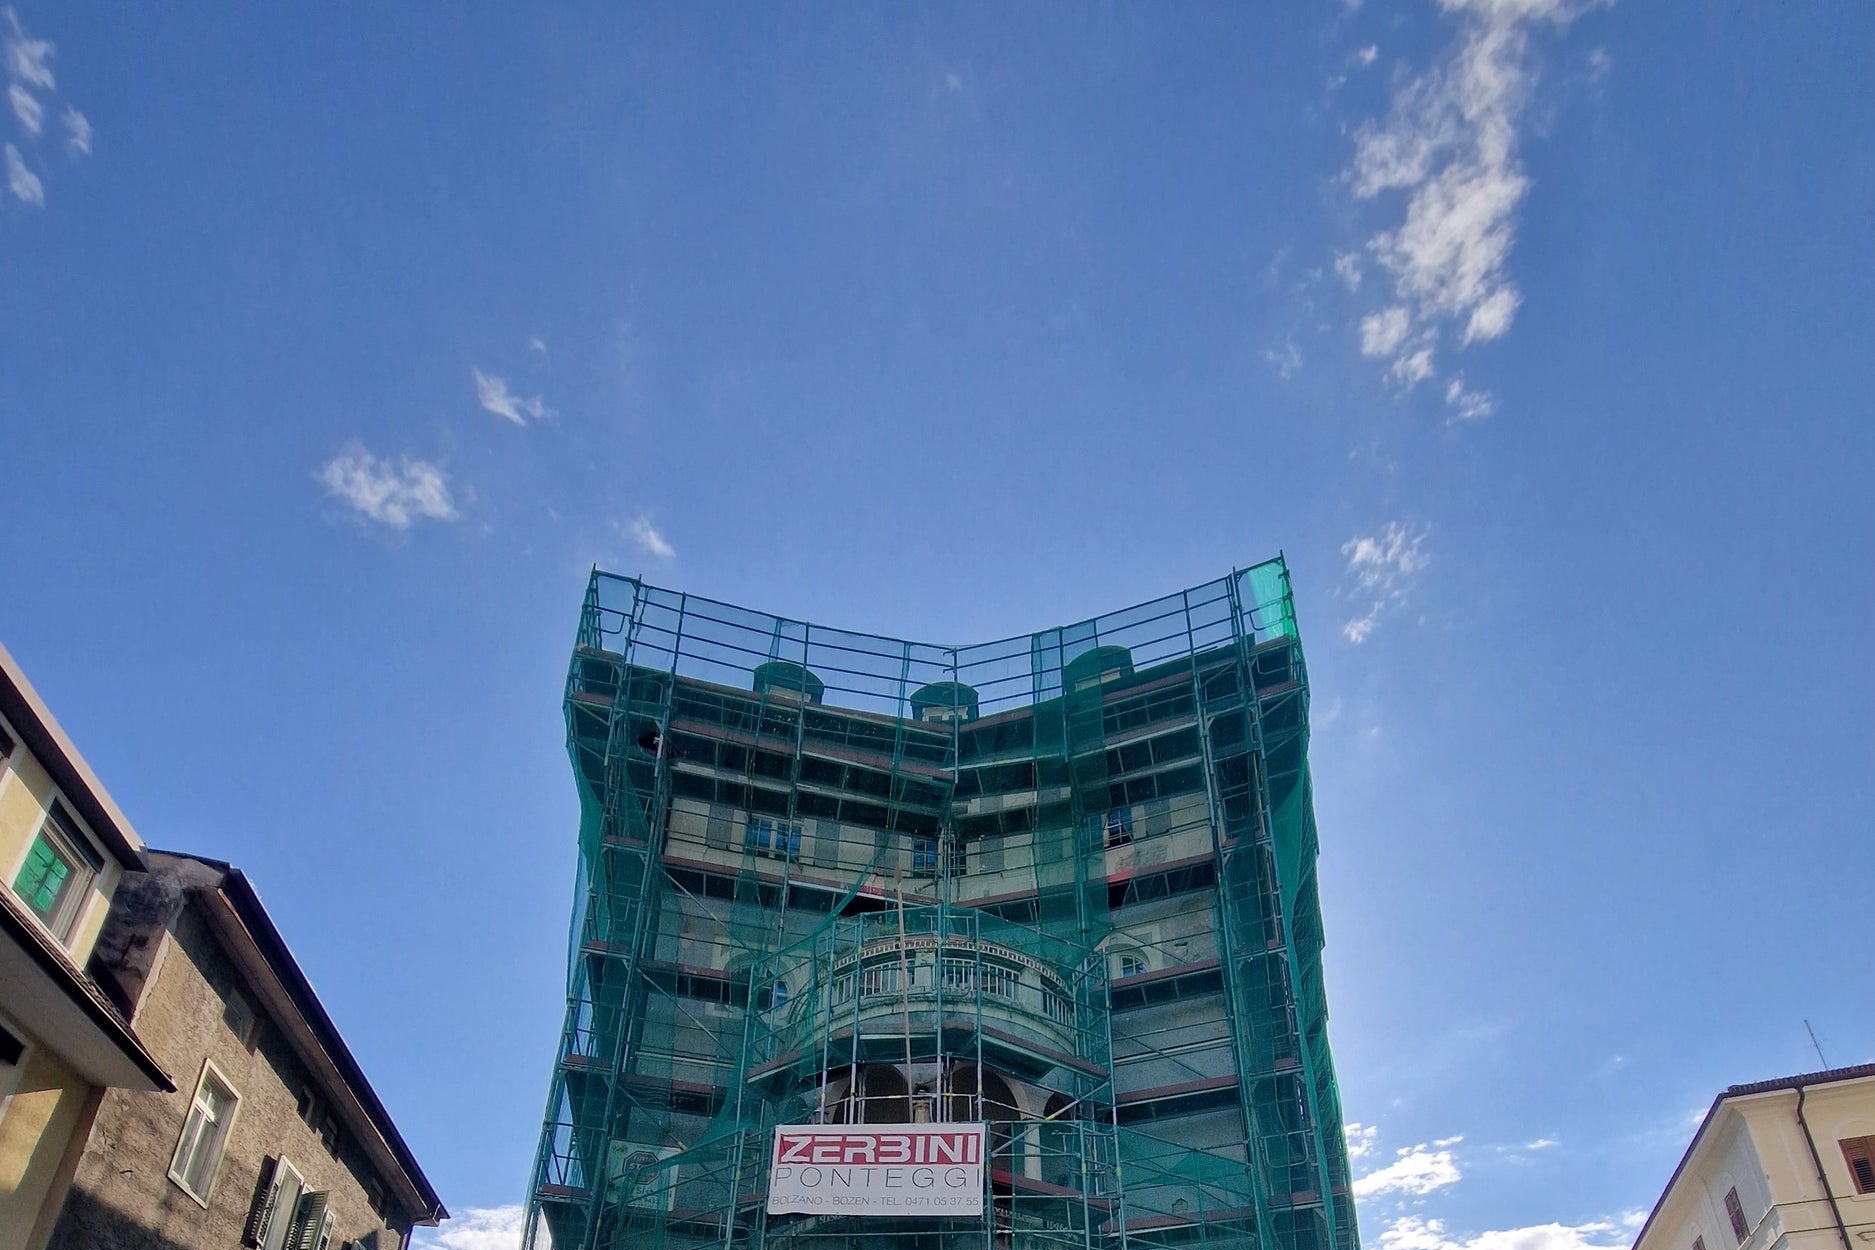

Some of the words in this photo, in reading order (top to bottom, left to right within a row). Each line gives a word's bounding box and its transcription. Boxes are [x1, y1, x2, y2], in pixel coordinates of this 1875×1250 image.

[781, 1135, 977, 1163] ZERBINI
[774, 1166, 980, 1188] PONTEGGI
[771, 1195, 823, 1206] BOLZANO
[832, 1196, 870, 1206] BOZEN
[905, 1196, 930, 1206] 0471
[933, 1196, 947, 1206] 05
[949, 1196, 961, 1206] 37
[966, 1196, 979, 1206] 55
